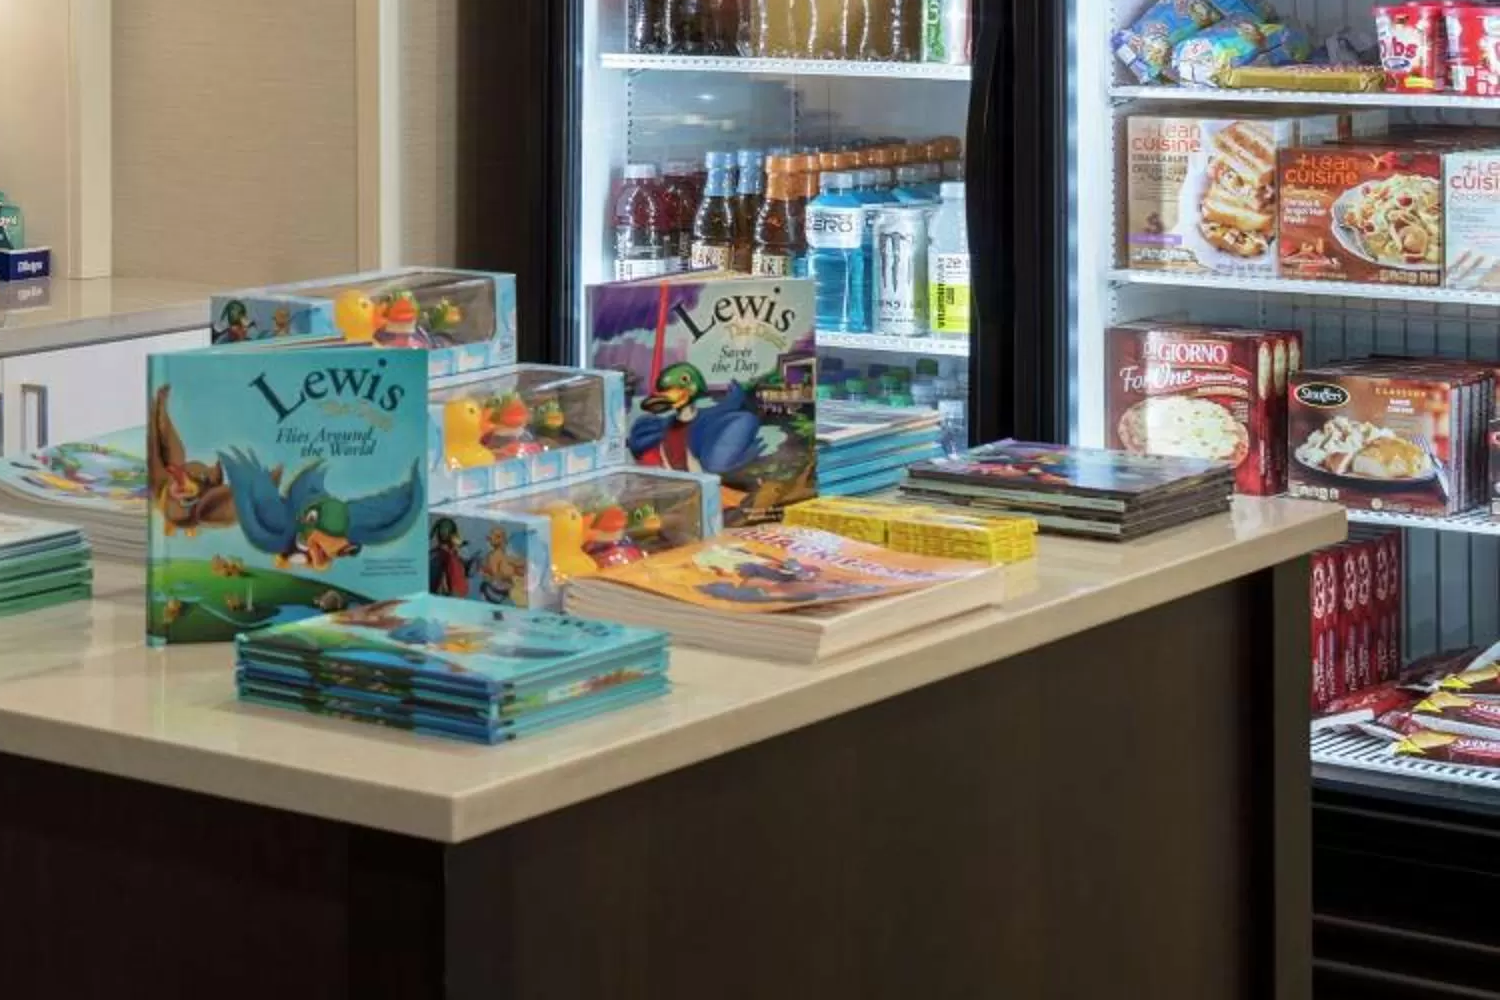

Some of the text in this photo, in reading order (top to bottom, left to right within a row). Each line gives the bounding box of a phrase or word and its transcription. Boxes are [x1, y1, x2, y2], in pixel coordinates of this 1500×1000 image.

[811, 218, 854, 234] ERO
[669, 285, 796, 346] Lewis
[249, 357, 406, 425] Lewis
[275, 426, 375, 445] Flies Around
[299, 440, 377, 457] the World
